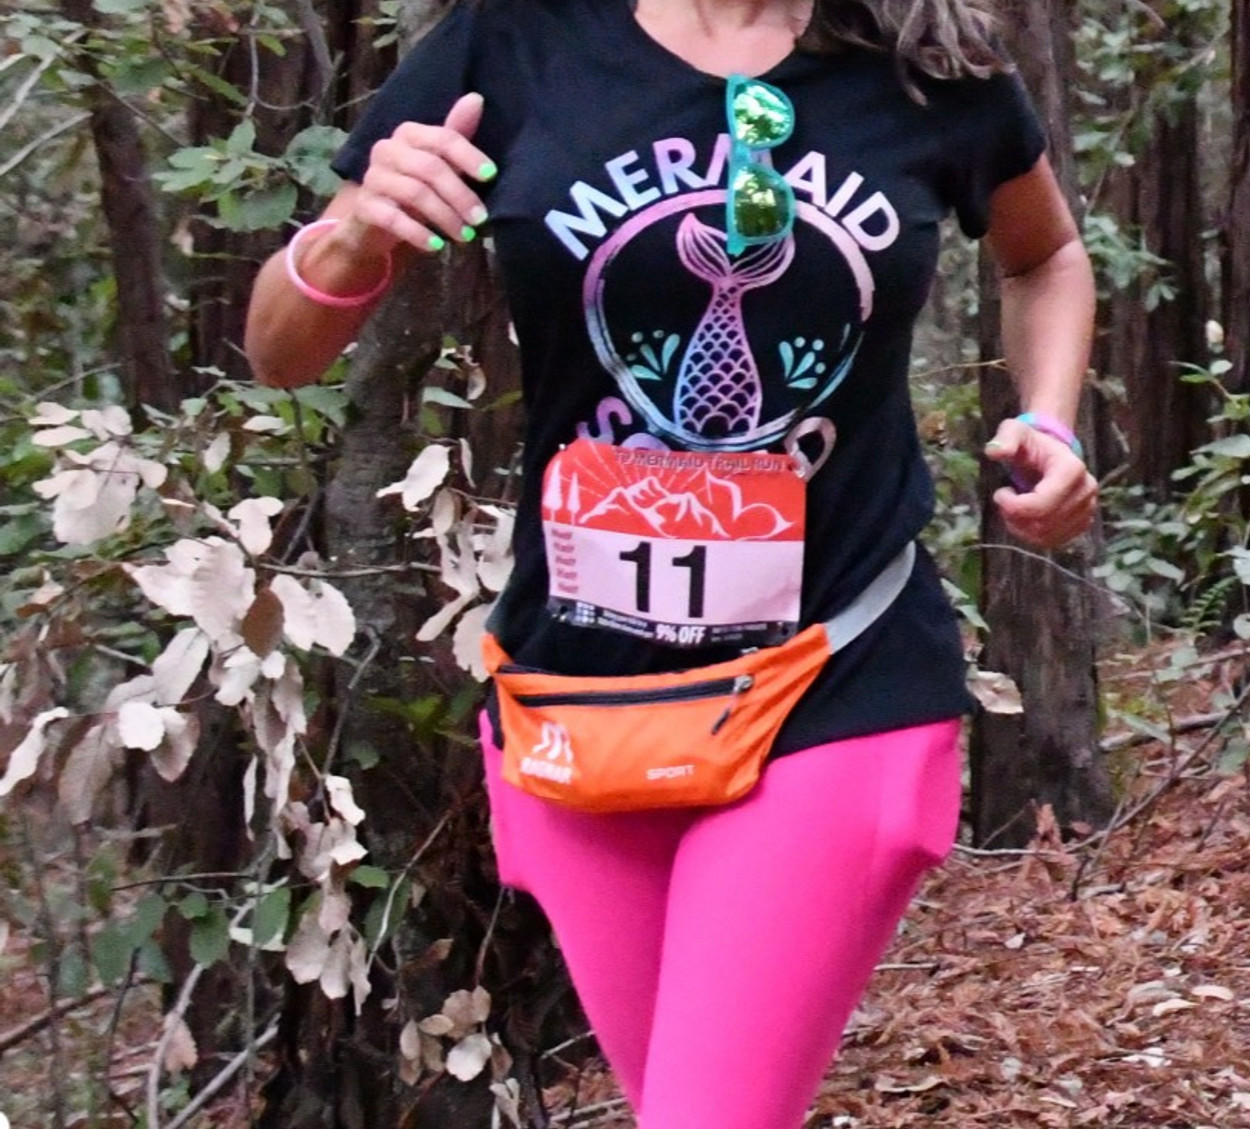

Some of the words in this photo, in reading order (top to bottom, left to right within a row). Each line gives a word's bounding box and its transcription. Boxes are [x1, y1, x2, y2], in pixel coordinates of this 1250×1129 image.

[619, 541, 707, 618] 11
[656, 624, 677, 643] 9%
[678, 626, 706, 644] OFF
[646, 764, 695, 780] SPORT
